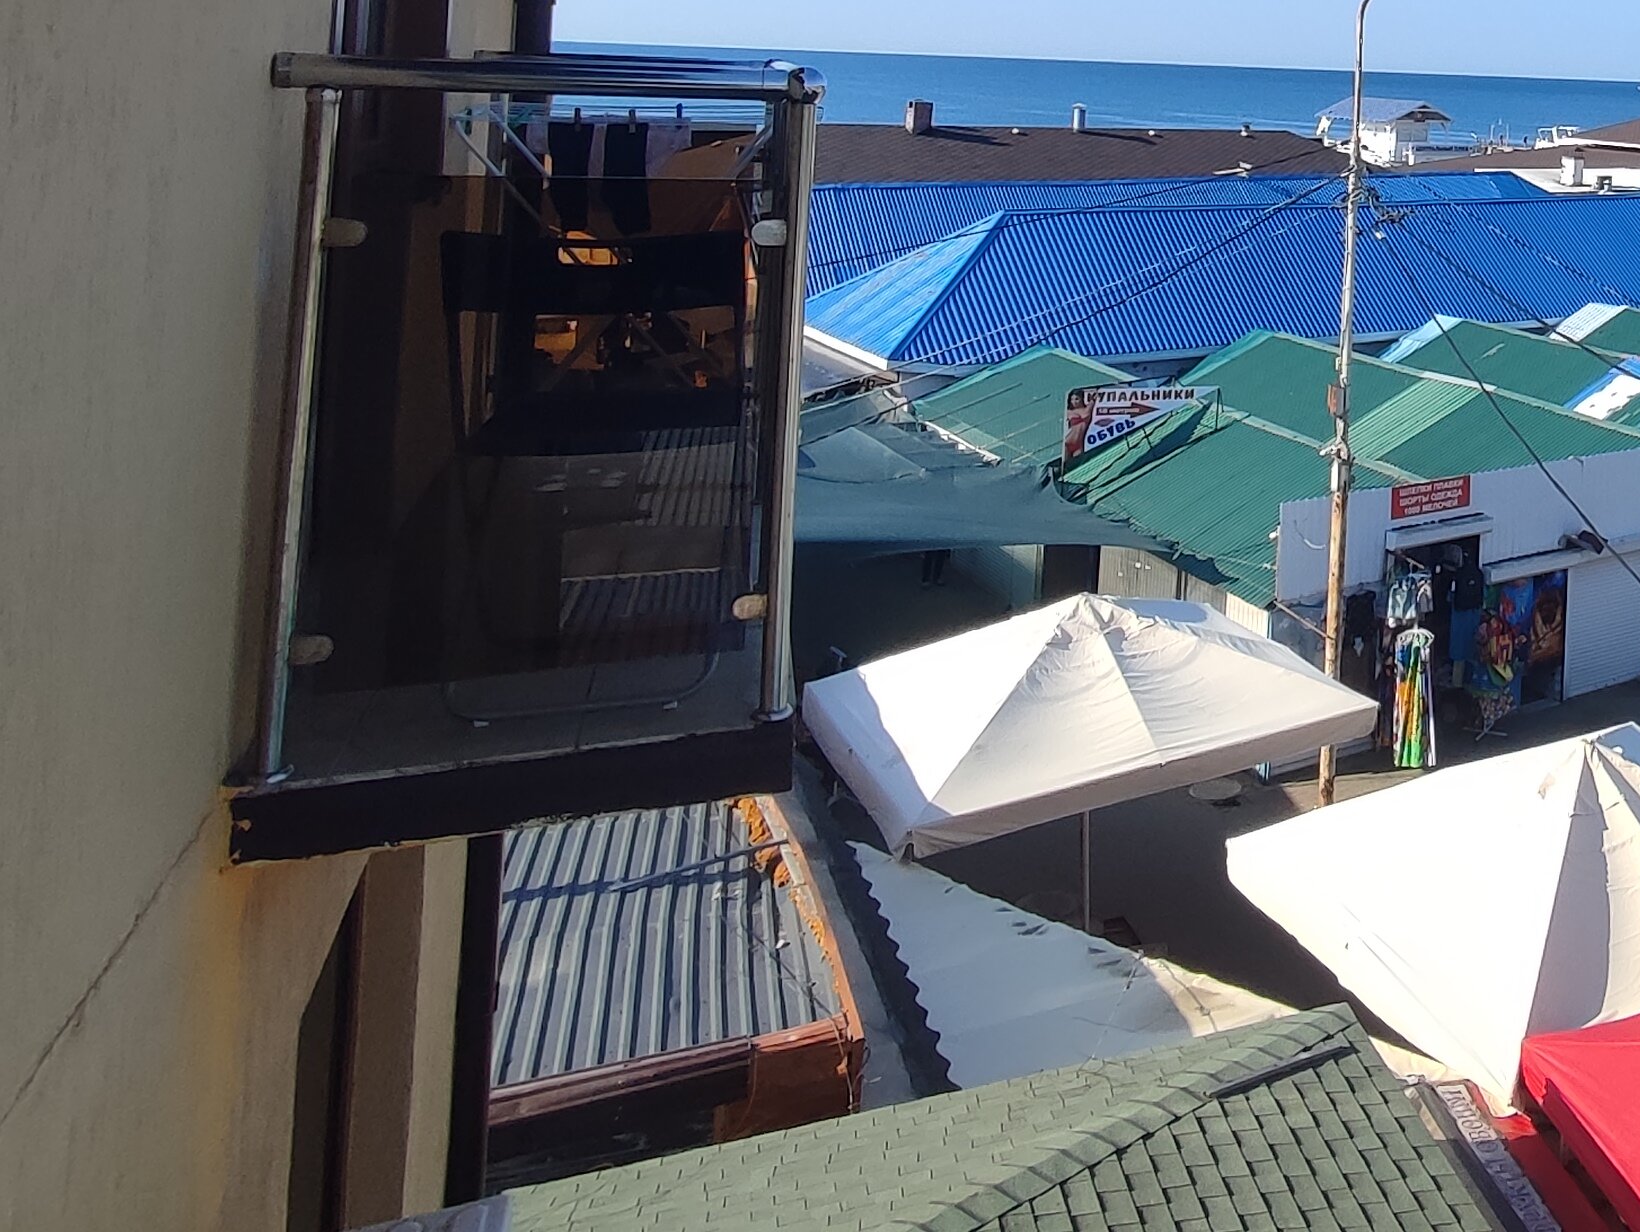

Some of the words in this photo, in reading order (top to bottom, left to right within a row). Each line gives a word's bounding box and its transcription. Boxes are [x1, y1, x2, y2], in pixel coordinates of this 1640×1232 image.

[1087, 388, 1195, 403] КУПАЛЬНИКИ
[1087, 419, 1136, 445] ОБУВЬ
[1400, 494, 1429, 506] ШОРТЫ
[1431, 488, 1462, 501] ОДЕЖДА
